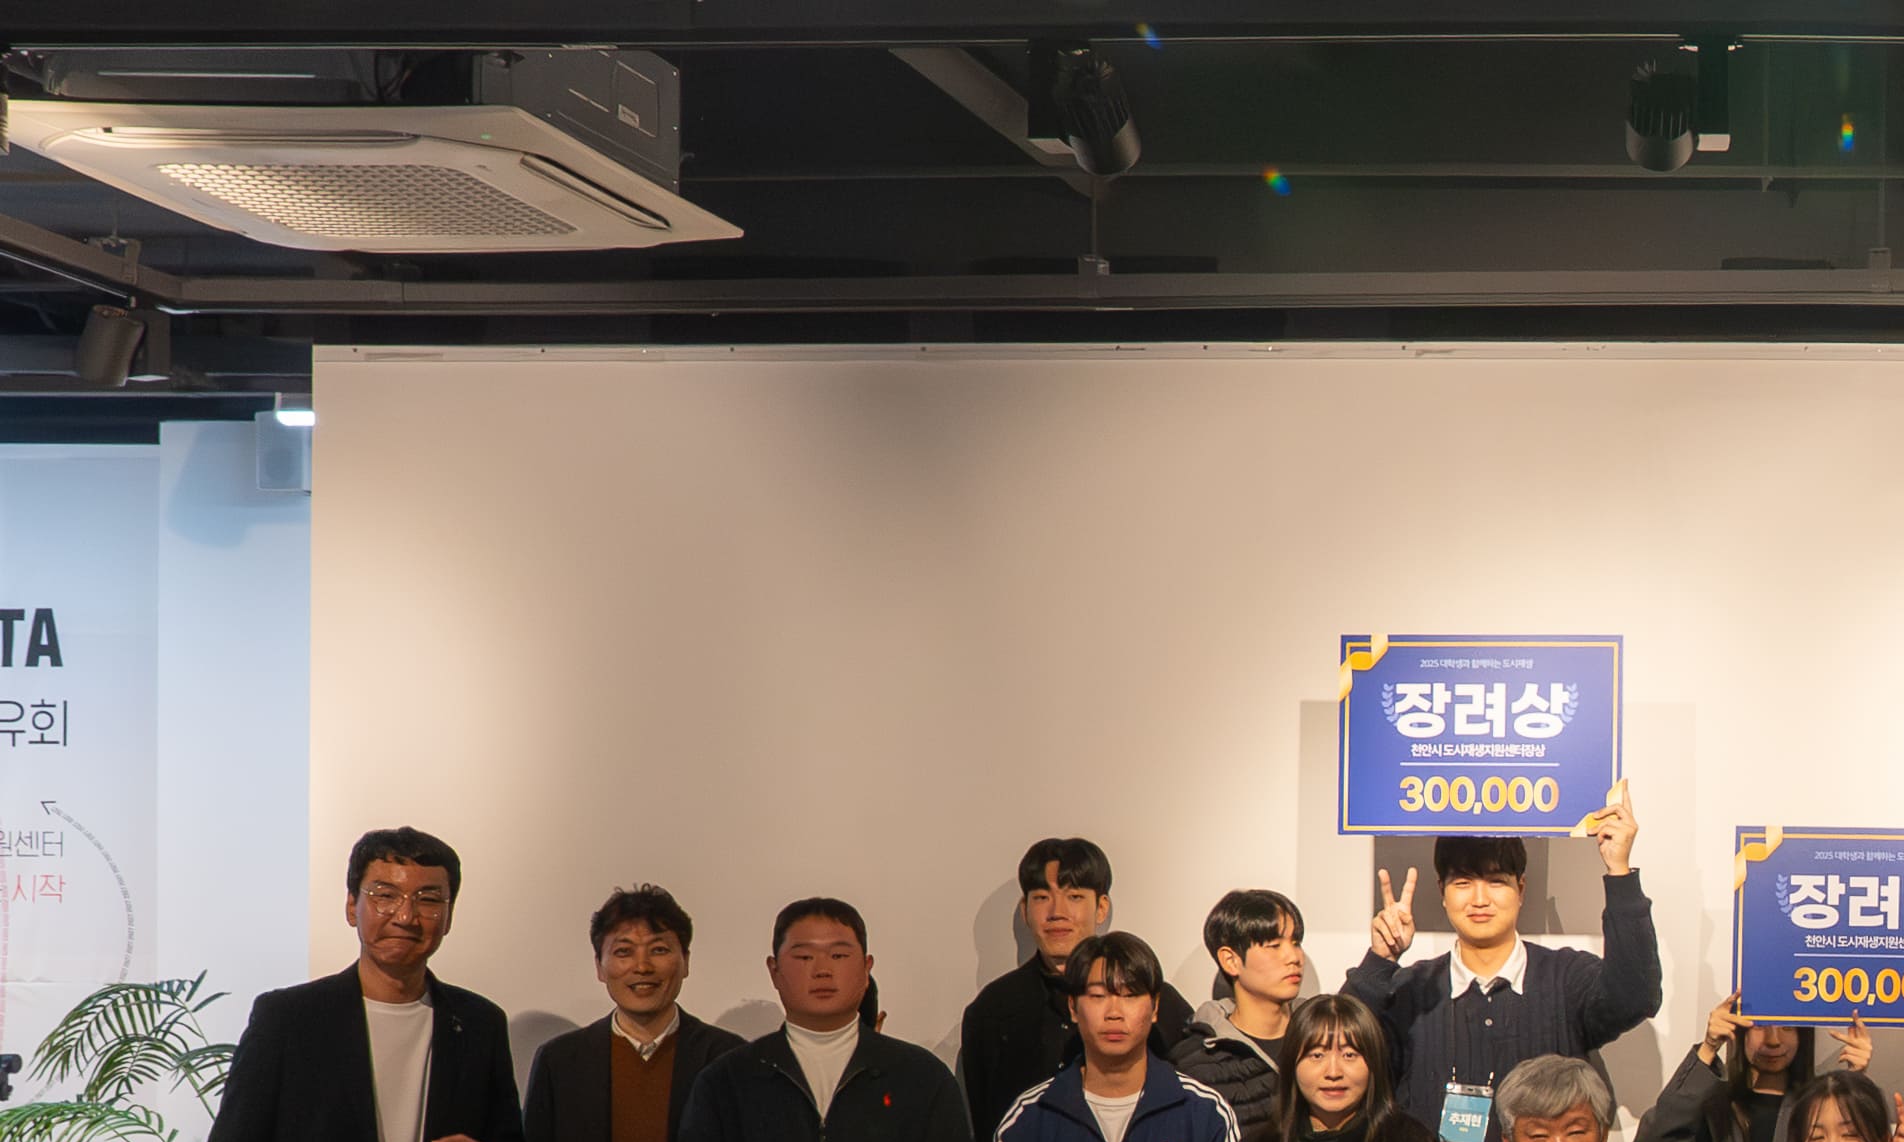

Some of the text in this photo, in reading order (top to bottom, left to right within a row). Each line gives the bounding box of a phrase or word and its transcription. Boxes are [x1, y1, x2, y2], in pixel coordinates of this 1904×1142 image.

[1395, 683, 1570, 738] 장려상
[1411, 743, 1546, 758] 천안시 도시재생지원센터장상
[1399, 776, 1560, 814] 300,000
[12, 875, 66, 904] 시작
[1805, 935, 1836, 948] 천안시
